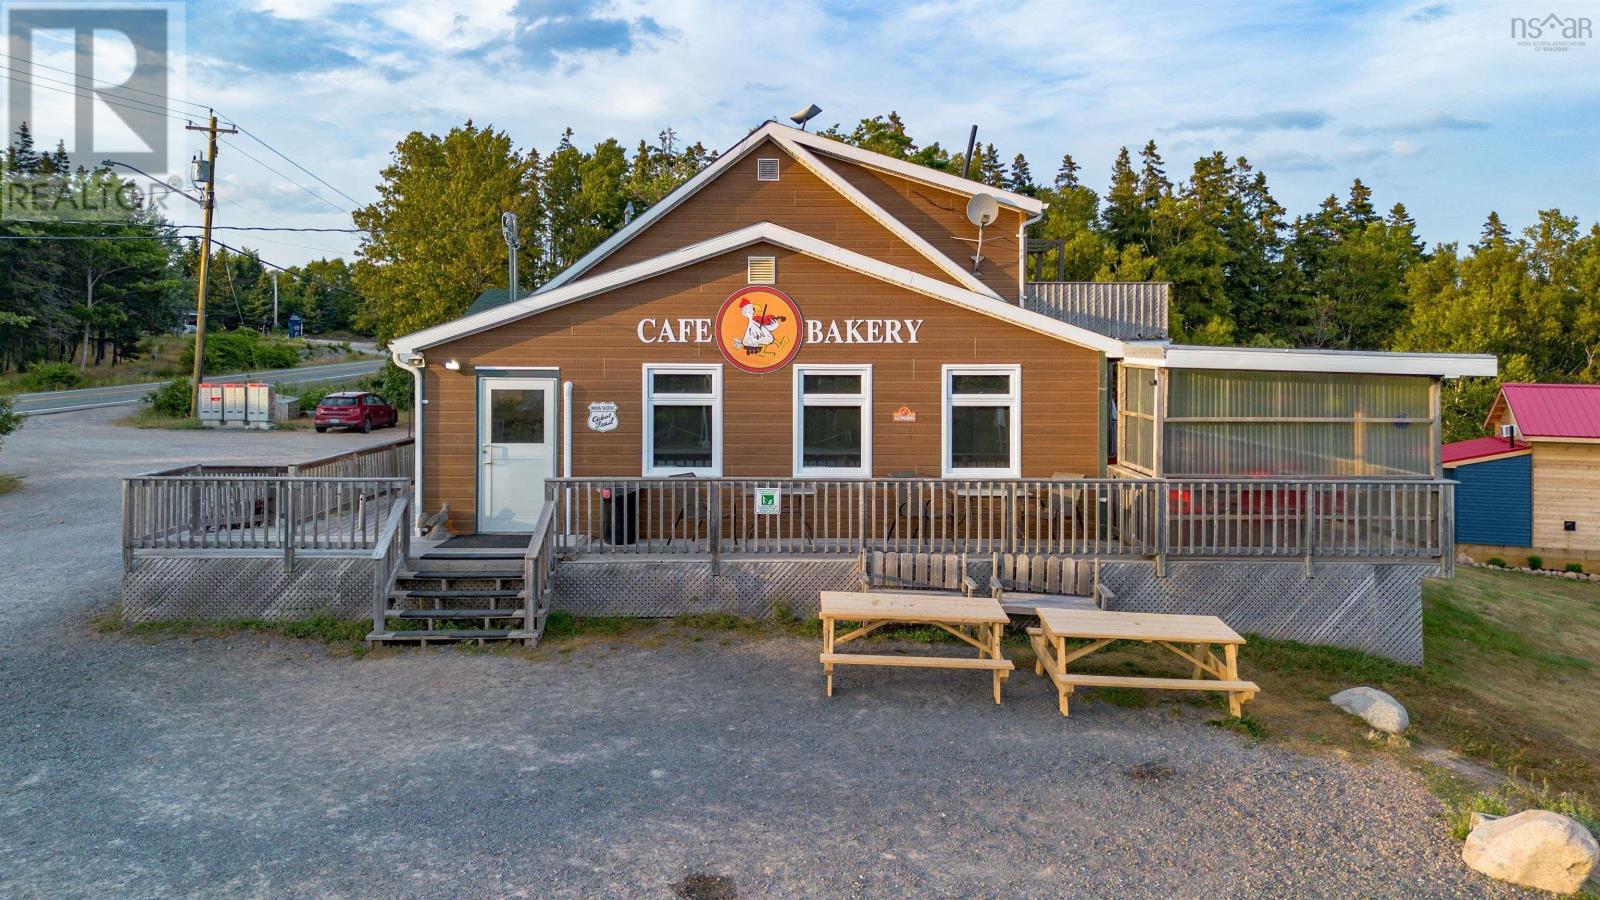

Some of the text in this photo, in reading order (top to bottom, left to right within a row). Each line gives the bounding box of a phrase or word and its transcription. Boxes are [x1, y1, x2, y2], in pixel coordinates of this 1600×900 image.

[637, 318, 924, 344] CAFE BAKERY
[592, 413, 611, 422] Cabot
[595, 417, 614, 428] Trail
